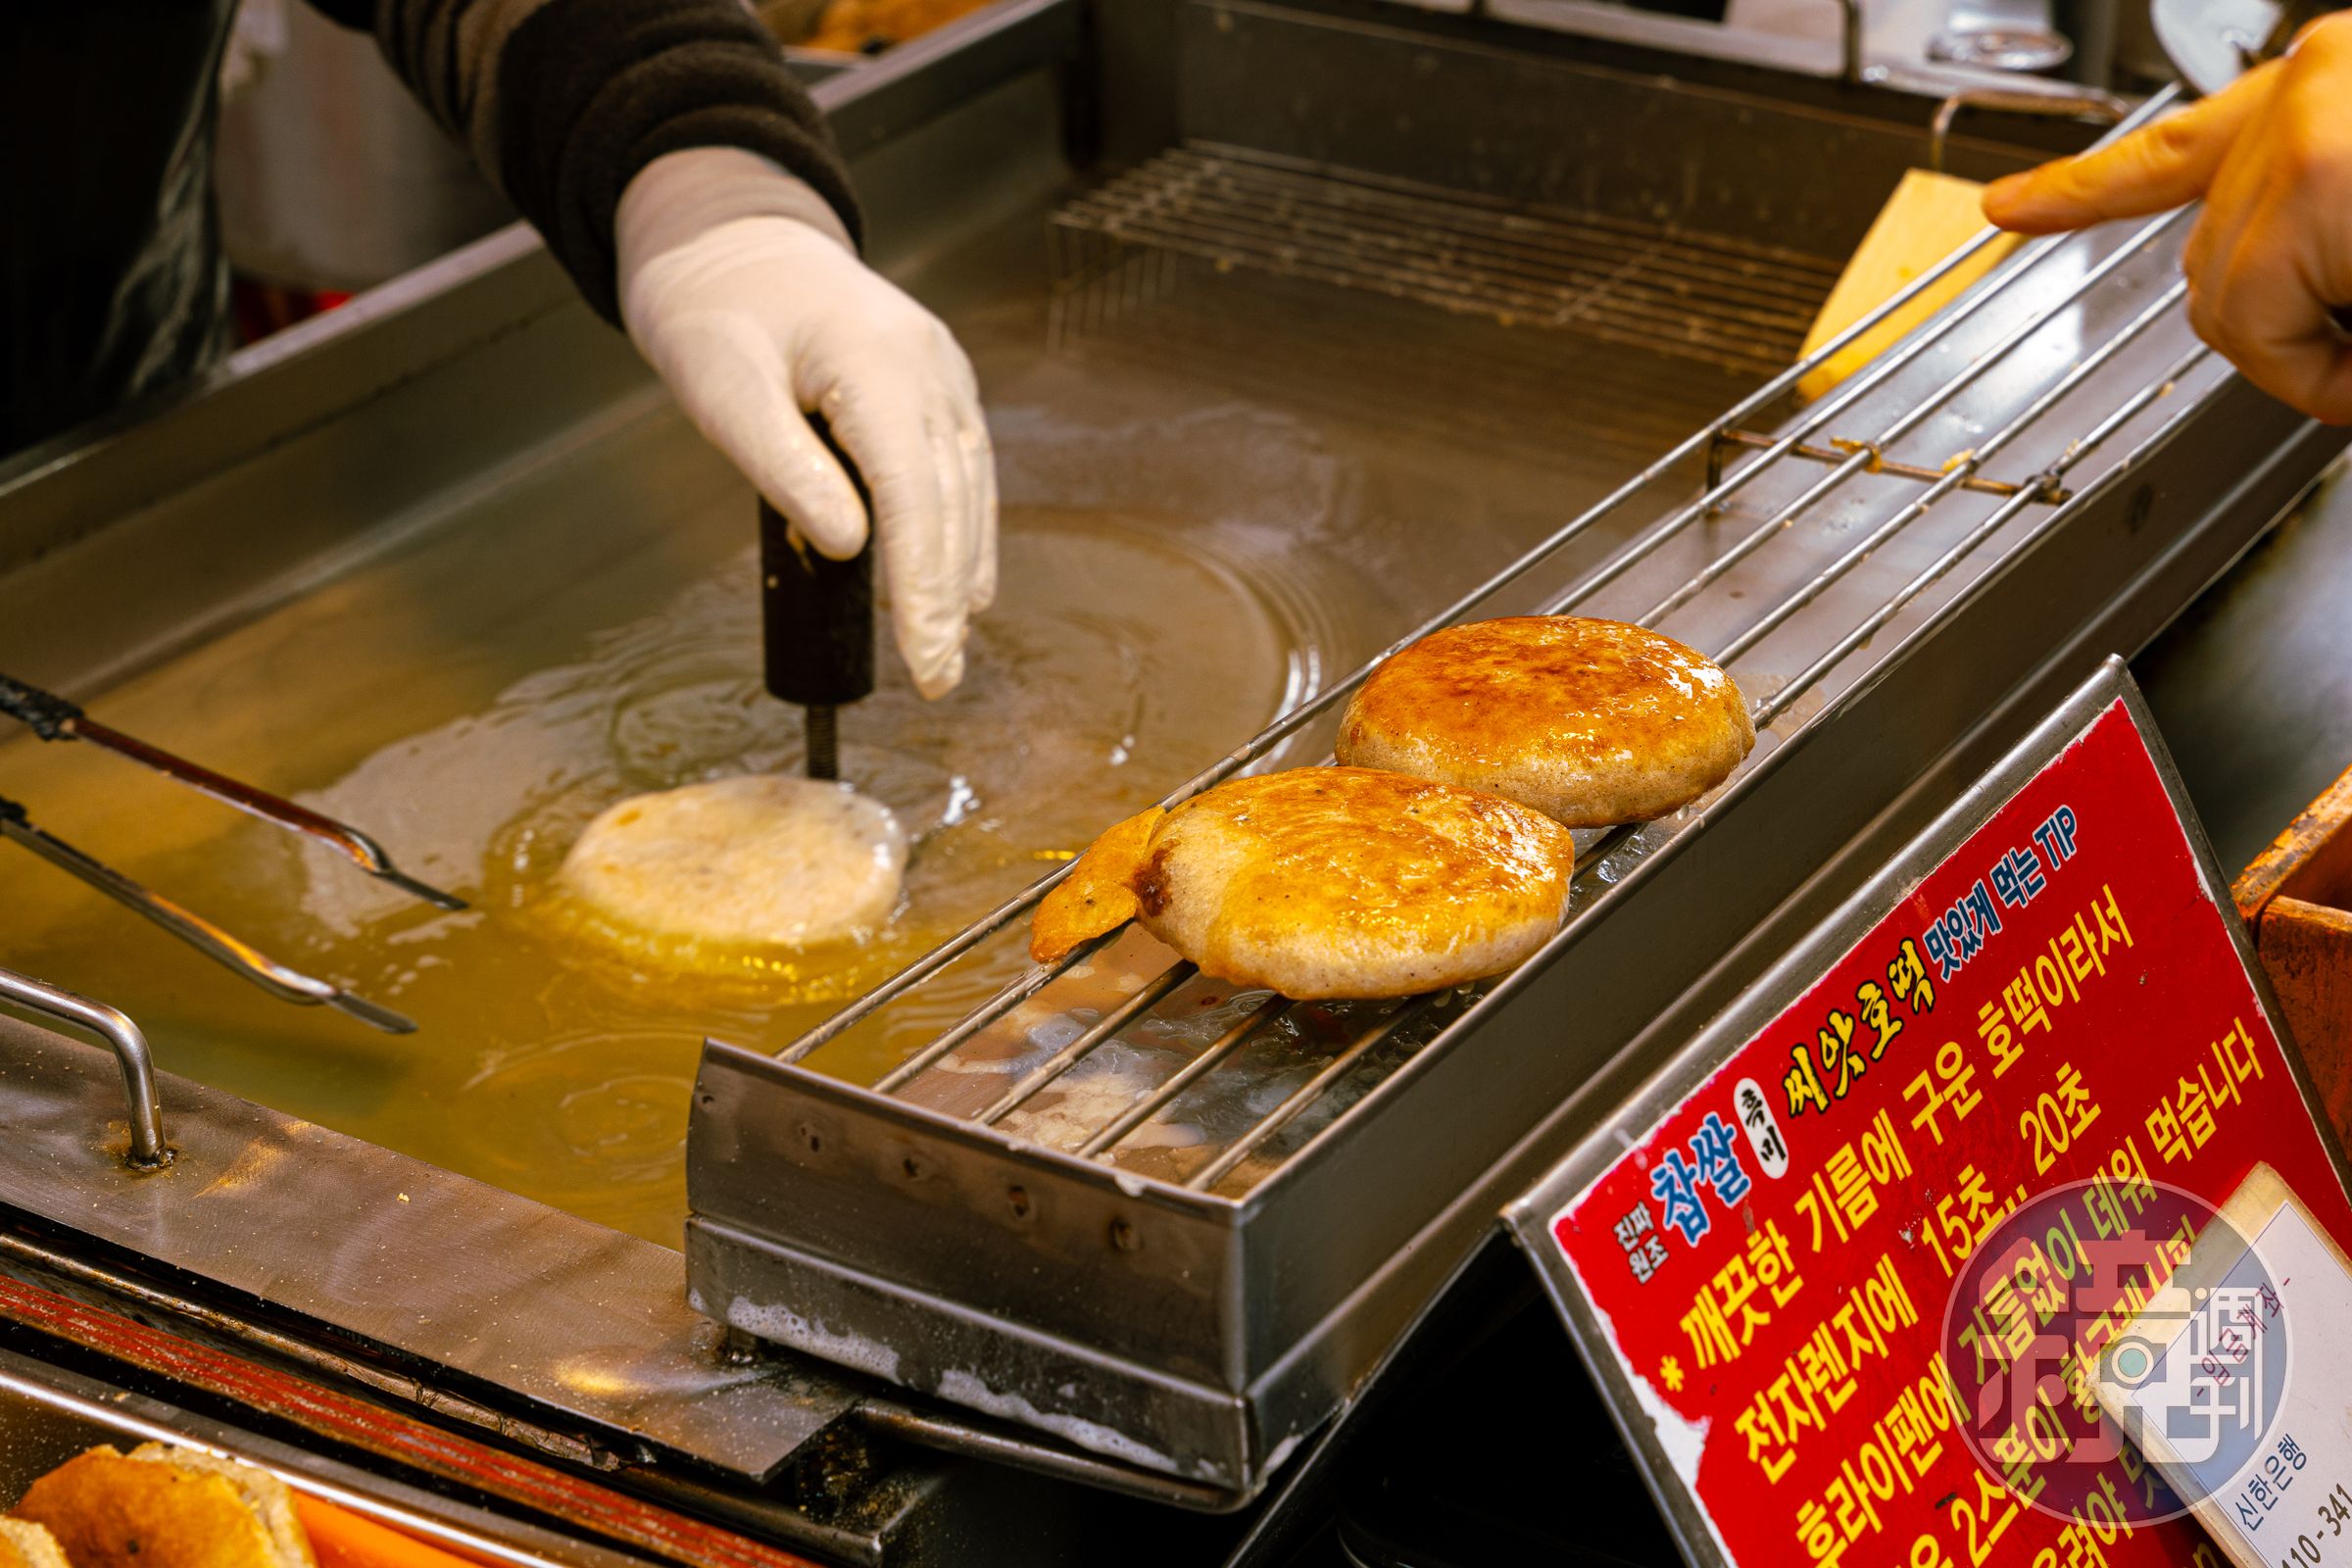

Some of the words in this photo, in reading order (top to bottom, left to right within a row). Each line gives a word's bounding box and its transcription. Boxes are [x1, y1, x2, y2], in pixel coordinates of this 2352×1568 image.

[1650, 1111, 1751, 1248] 찹쌀
[1922, 878, 2003, 983] 맛있게
[1990, 847, 2046, 909] 먹는
[2033, 805, 2077, 870] TIP
[1679, 1218, 1804, 1369] 깨끗한
[1794, 1107, 1913, 1252] 기름에
[1902, 1042, 1984, 1147] 구운
[1977, 883, 2134, 1080] 호떡이라서
[1628, 1235, 1669, 1284] 원조
[1734, 1252, 1919, 1485] 전자렌지에
[2020, 1061, 2101, 1176] 20초
[1795, 1350, 1972, 1568] 후라이팬에
[1958, 1208, 2093, 1385] 기름없이
[2082, 1136, 2158, 1242] 데워
[2144, 1016, 2265, 1164] 먹습니다
[2235, 1433, 2307, 1531] 신한은행
